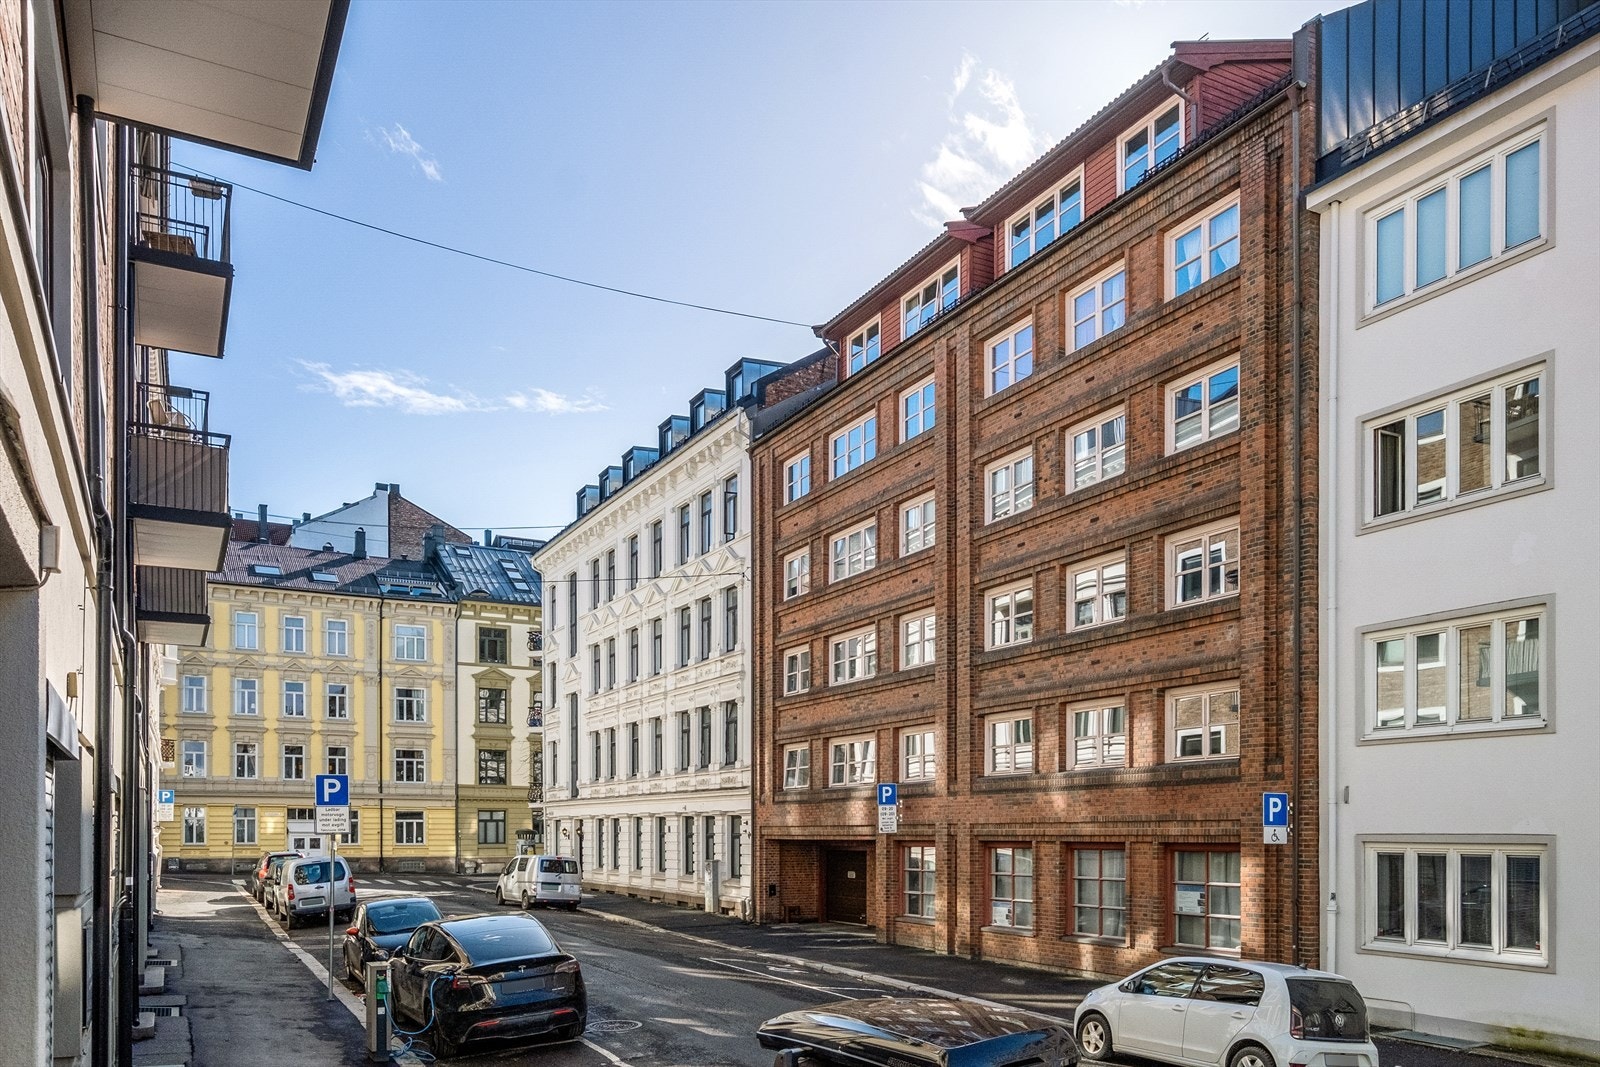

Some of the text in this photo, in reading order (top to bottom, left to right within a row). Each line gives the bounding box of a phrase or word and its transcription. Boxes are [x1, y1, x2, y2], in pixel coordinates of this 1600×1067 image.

[162, 791, 171, 802] P
[324, 779, 341, 802] P
[882, 786, 892, 803] P
[1269, 797, 1282, 822] P
